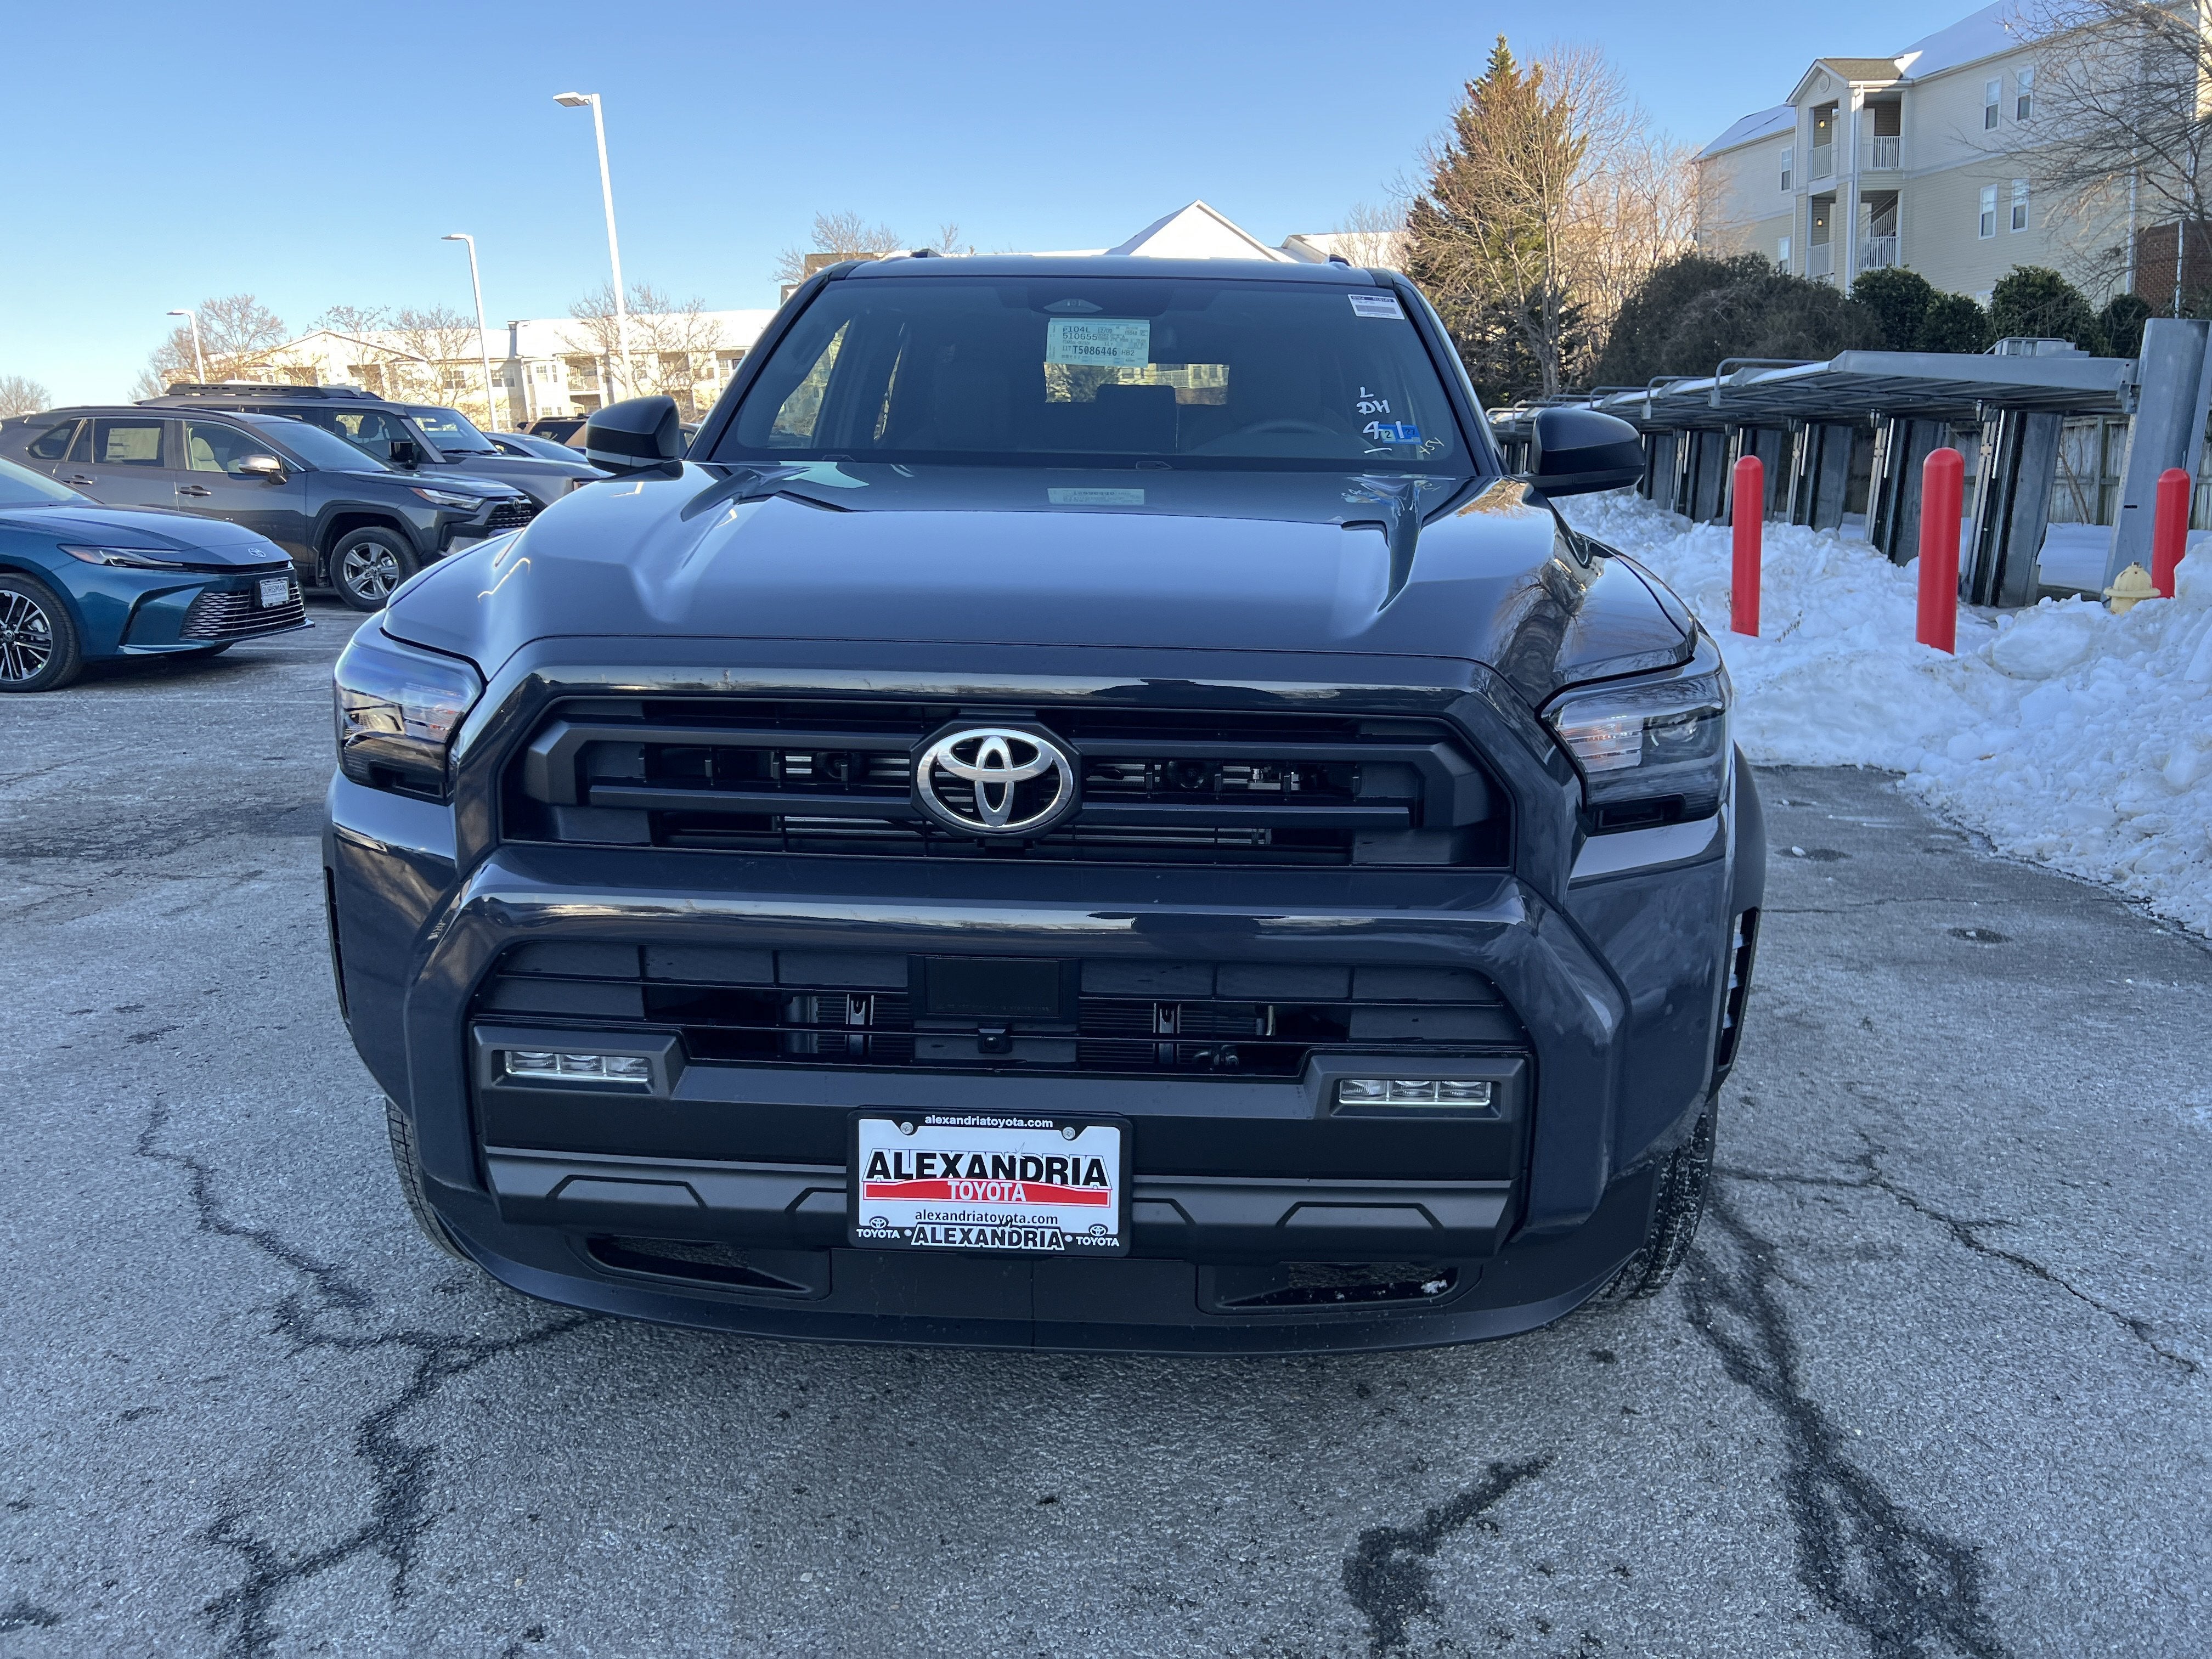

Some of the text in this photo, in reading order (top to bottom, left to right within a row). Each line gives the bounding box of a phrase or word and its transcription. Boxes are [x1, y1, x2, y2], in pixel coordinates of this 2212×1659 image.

[1063, 332, 1097, 341] 510655
[1073, 345, 1118, 357] T5086446
[1359, 386, 1374, 398] L
[1384, 430, 1392, 439] 2
[925, 1114, 1053, 1129] alexandriatoyota.com
[865, 1150, 1109, 1187] ALEXANDRIA
[947, 1181, 1026, 1202] TOYOTA
[915, 1209, 1058, 1225] alexandriatoyota.com
[856, 1228, 900, 1239] TOYOTA
[912, 1224, 1064, 1250] ALEXANDRIA
[1075, 1235, 1120, 1248] TOYOTA
